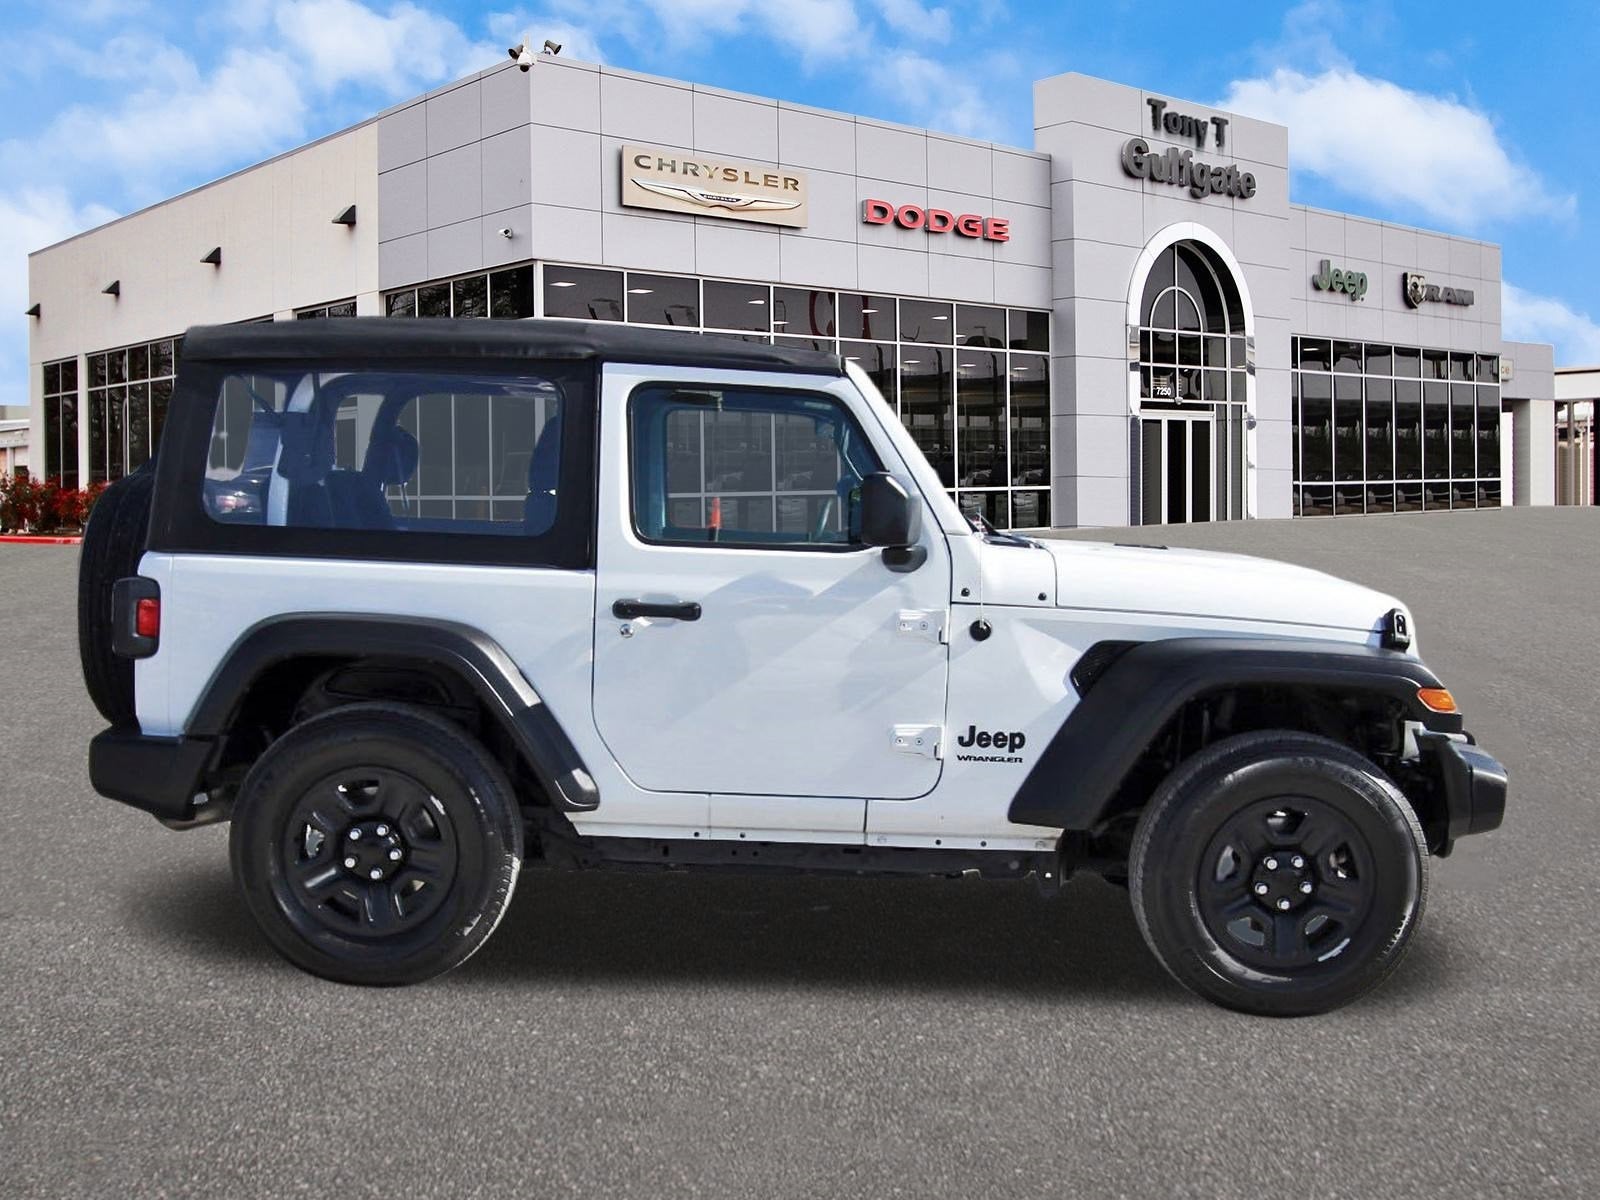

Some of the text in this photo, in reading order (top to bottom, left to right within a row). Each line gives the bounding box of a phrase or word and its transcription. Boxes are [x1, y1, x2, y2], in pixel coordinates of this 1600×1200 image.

[1147, 98, 1229, 148] Tony T
[633, 154, 800, 192] CHRYSLER
[1121, 138, 1256, 199] Gulfgate
[862, 199, 1009, 242] DODGE
[1312, 259, 1368, 302] Jeep
[1425, 284, 1475, 306] RAM
[957, 725, 1026, 753] Jeep
[957, 754, 1023, 763] WRANGLER
